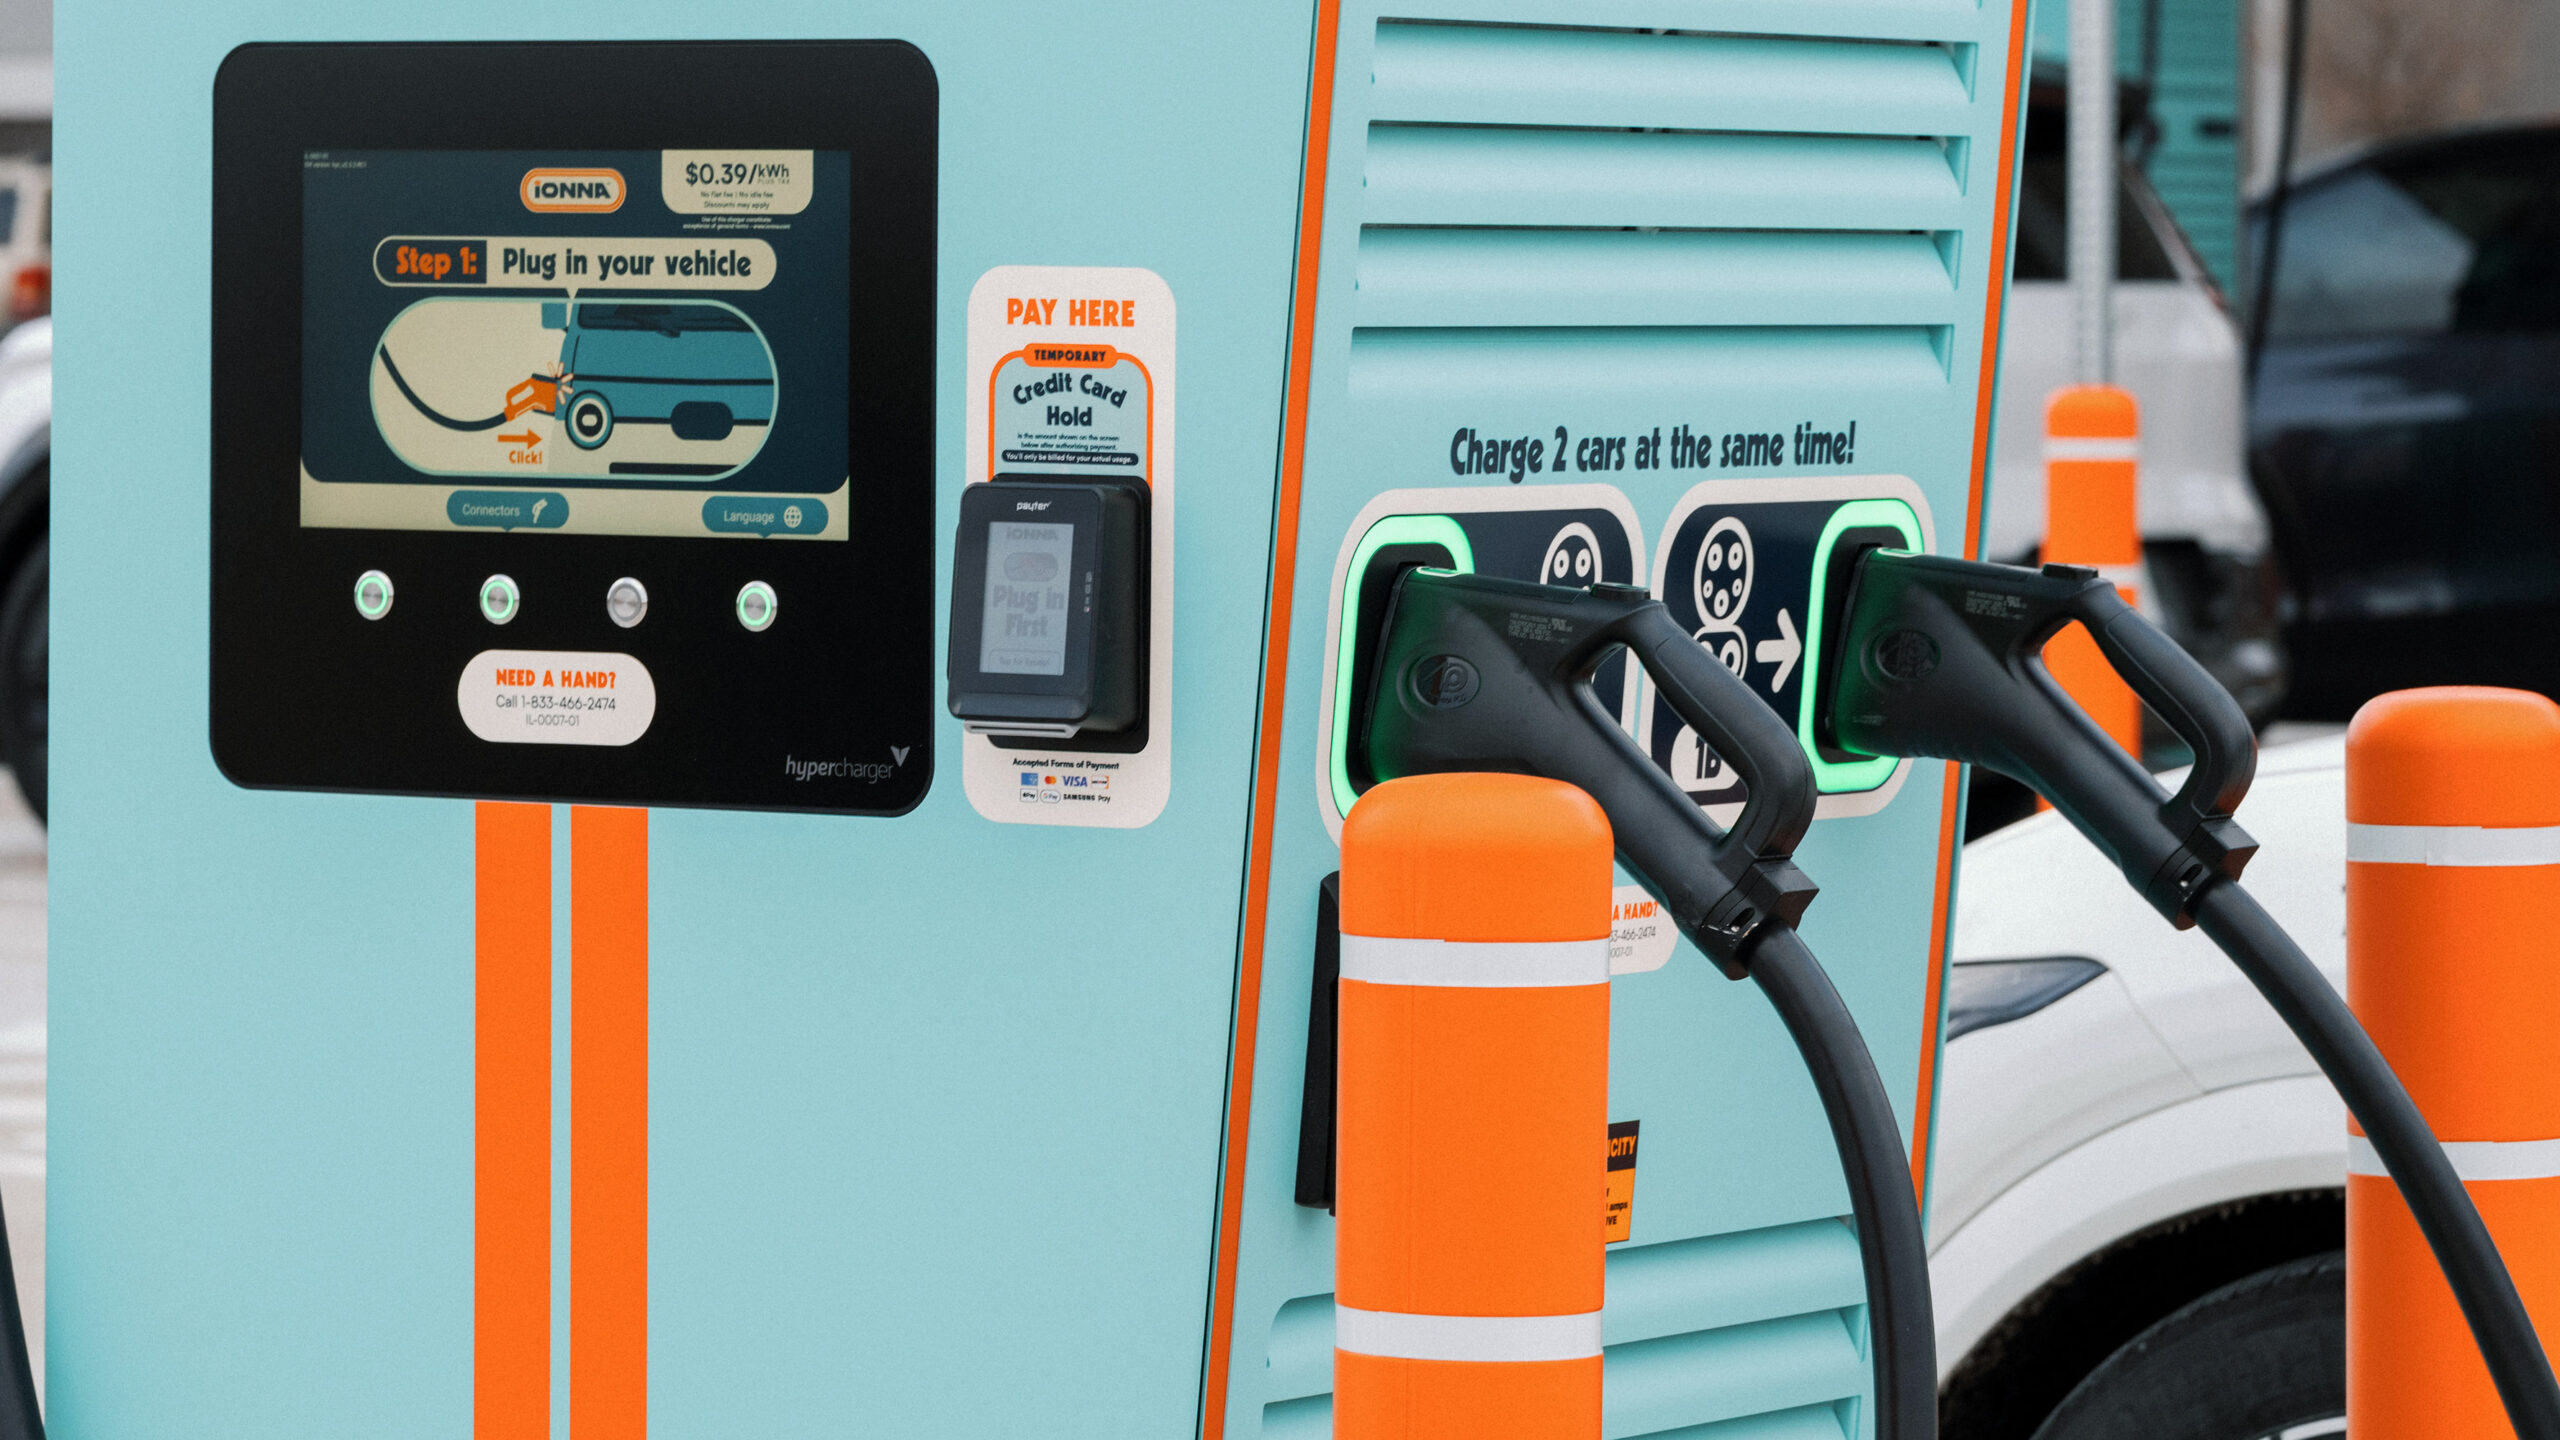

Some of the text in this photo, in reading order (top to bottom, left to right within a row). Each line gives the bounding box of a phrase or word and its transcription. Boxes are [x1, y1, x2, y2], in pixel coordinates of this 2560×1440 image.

[686, 160, 789, 187] $0.39/kWh
[704, 201, 770, 210] Discounts may apply
[396, 245, 752, 282] Step 1: Plug in your vehicle
[1007, 298, 1135, 328] PAY HERE
[1034, 349, 1106, 363] TEMPORARY
[1012, 372, 1128, 409] Credit Card
[1046, 406, 1093, 427] Hold
[1024, 432, 1034, 440] the
[508, 450, 542, 464] Click!
[1024, 453, 1038, 462] only
[1066, 454, 1076, 462] for
[1450, 420, 1856, 484] Charge 2 cars at the same time!
[462, 503, 520, 517] Connectors
[1016, 501, 1051, 512] payter
[724, 510, 775, 526] Language
[992, 584, 1064, 614] Plug in
[1005, 613, 1048, 638] First
[496, 668, 616, 689] NEED A HAND?
[496, 694, 616, 711] Call 1-833-466-2474
[526, 714, 580, 727] IL-0007-01
[785, 754, 894, 784] hypercharger
[1013, 758, 1120, 770] Accepted Forms of Payment
[1062, 776, 1088, 787] VISA
[1613, 900, 1658, 920] A HAND?
[1610, 1202, 1628, 1212] amps
